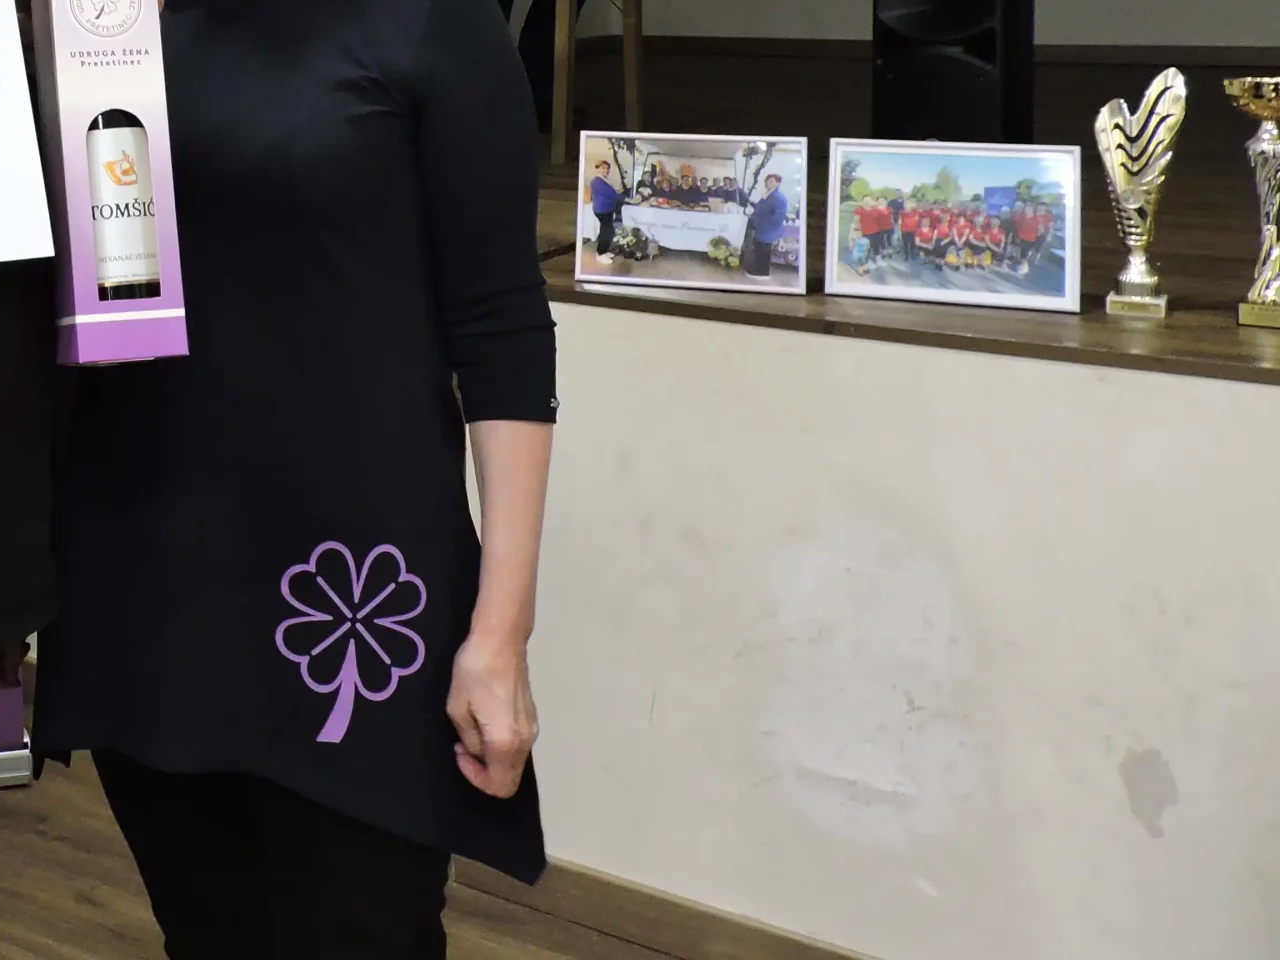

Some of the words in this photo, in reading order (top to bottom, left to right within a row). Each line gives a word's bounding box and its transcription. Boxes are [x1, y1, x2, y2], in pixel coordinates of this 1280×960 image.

[70, 49, 117, 58] UDRUGA
[122, 47, 150, 57] ŽENA
[80, 58, 142, 67] Pretetinec
[91, 196, 156, 221] TOMŠIĆ
